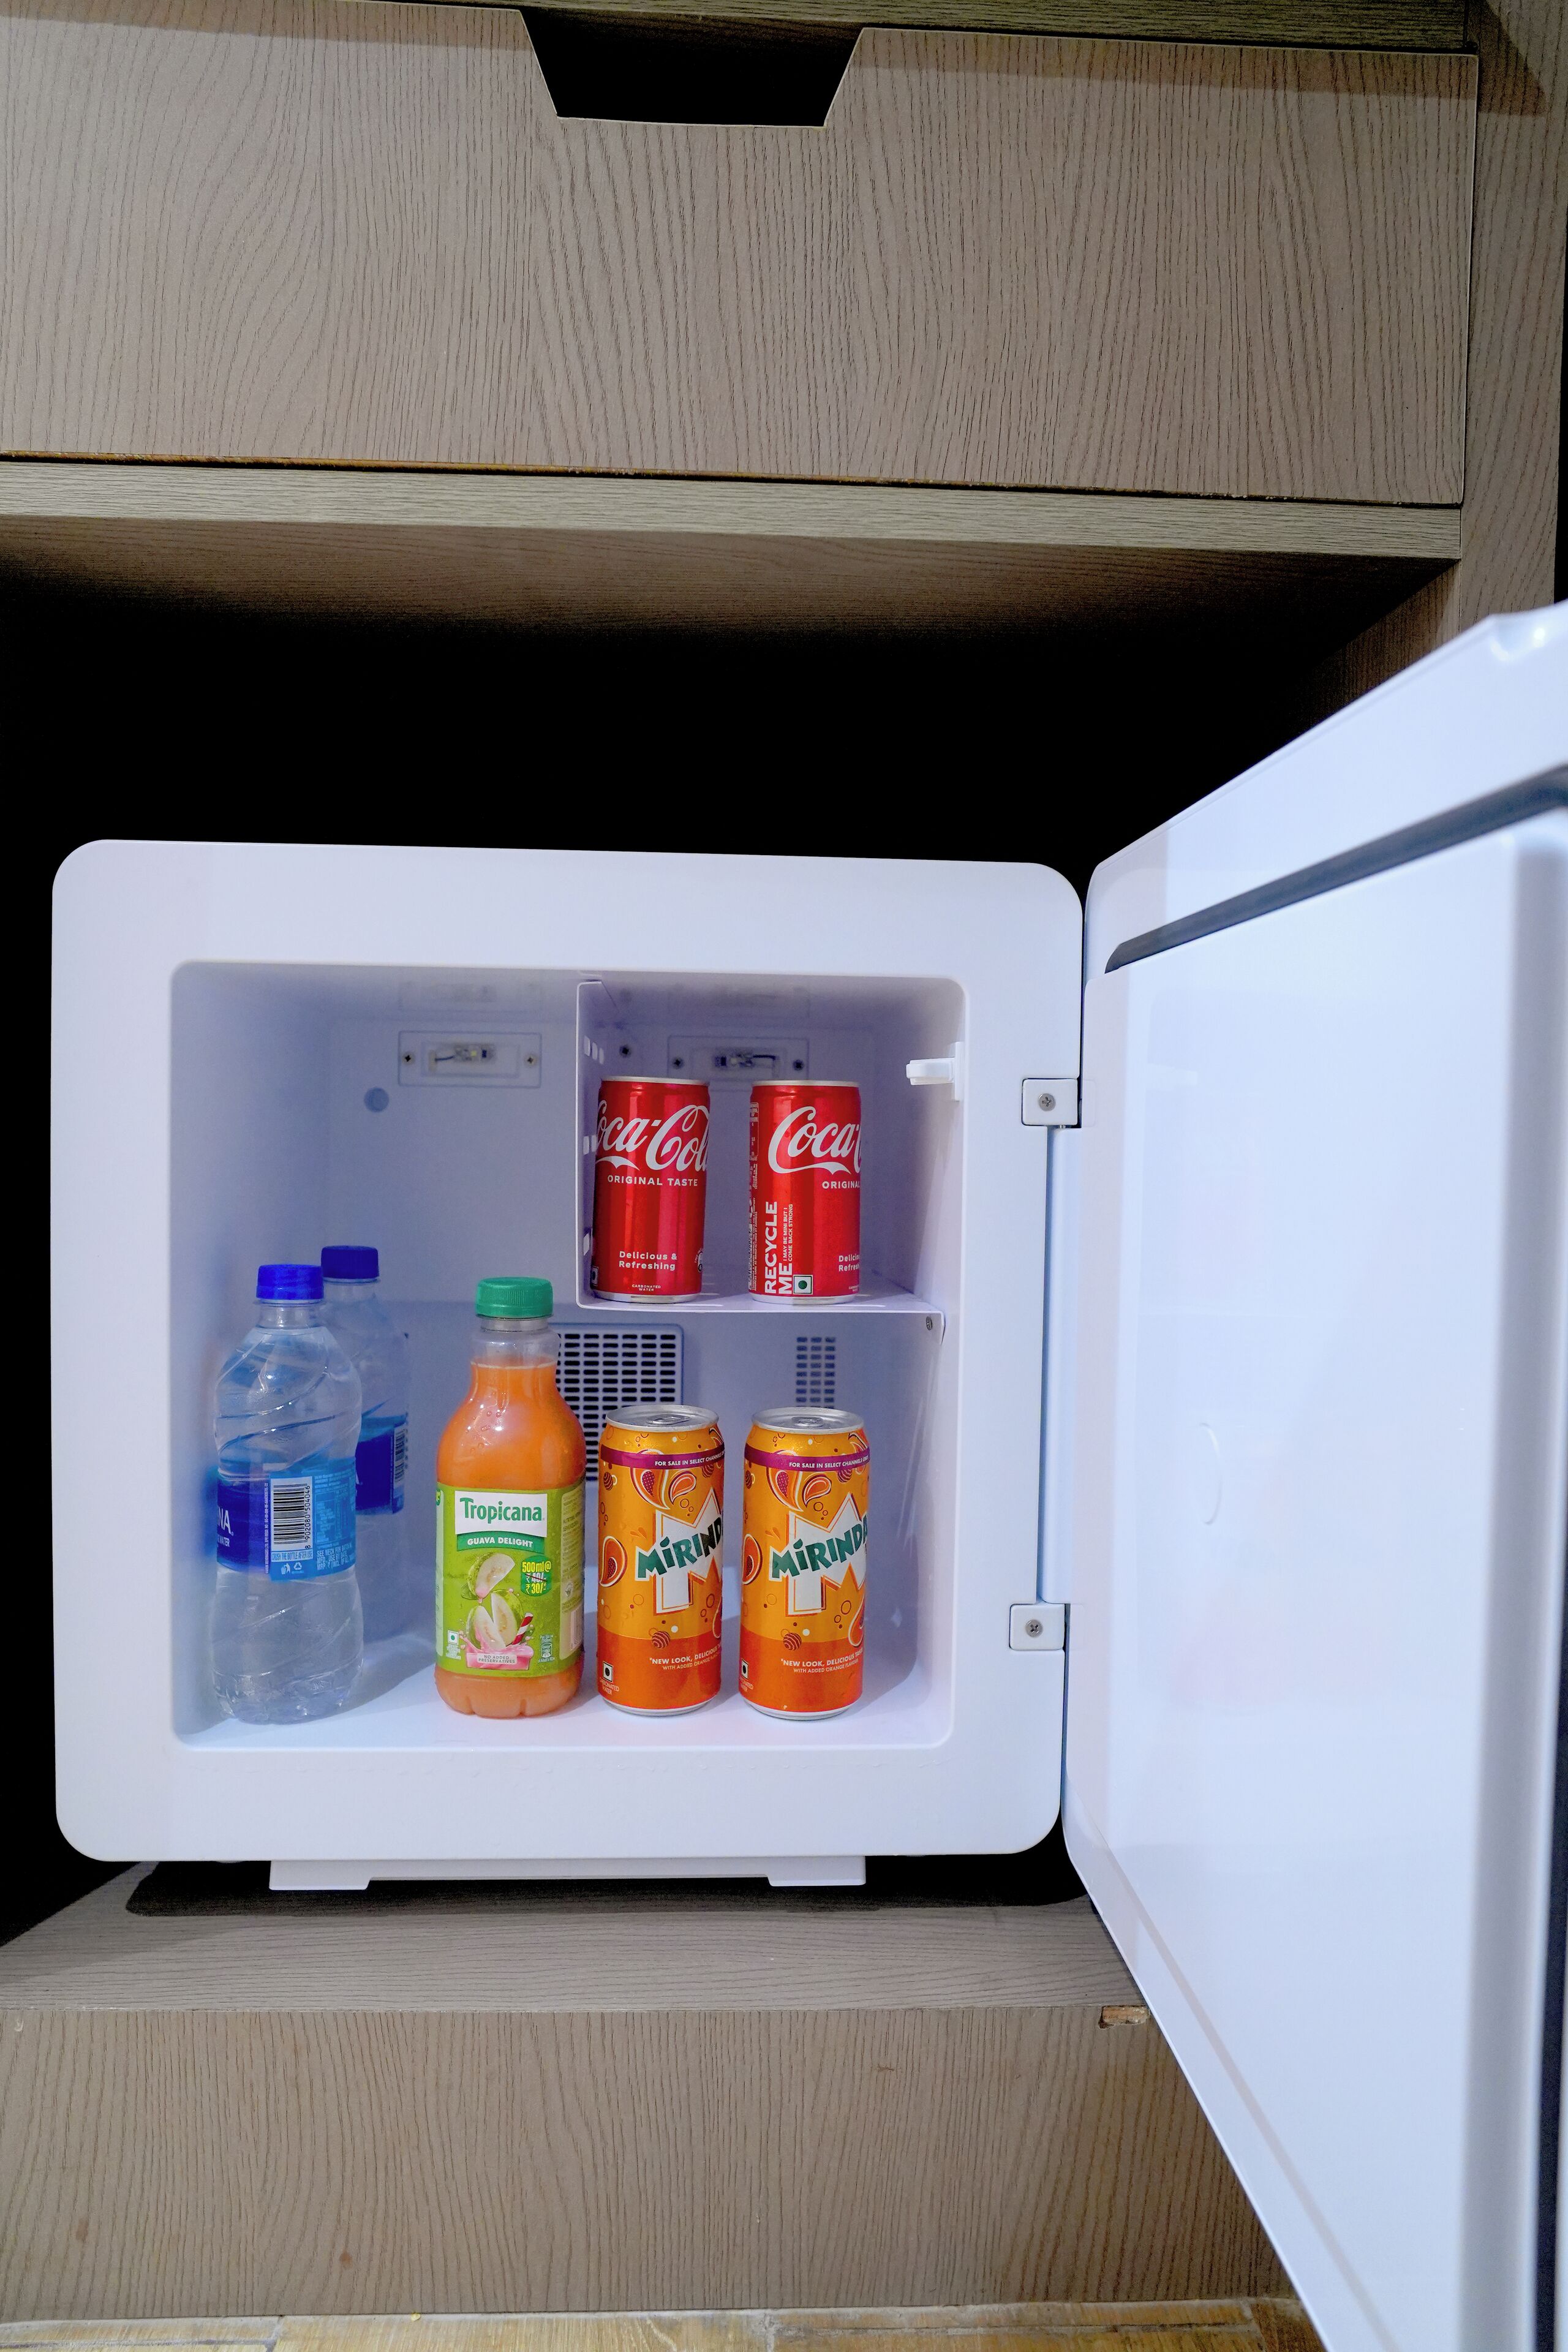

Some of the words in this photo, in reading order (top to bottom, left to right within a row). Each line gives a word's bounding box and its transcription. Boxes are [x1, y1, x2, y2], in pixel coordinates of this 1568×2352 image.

[768, 1106, 861, 1174] Coca-
[607, 1175, 663, 1186] ORIGINAL
[667, 1178, 698, 1186] TASTE
[764, 1201, 777, 1294] RECYCLE
[619, 1251, 668, 1260] Delicious
[619, 1261, 676, 1271] Refreshing
[778, 1262, 792, 1294] ME
[842, 1458, 862, 1466] CHANNELS
[459, 1497, 542, 1524] Tropicana
[467, 1537, 496, 1545] GUAVA
[498, 1537, 533, 1548] DELIGHT
[693, 1657, 710, 1667] ORANGE
[826, 1654, 854, 1666] DELICIOUS
